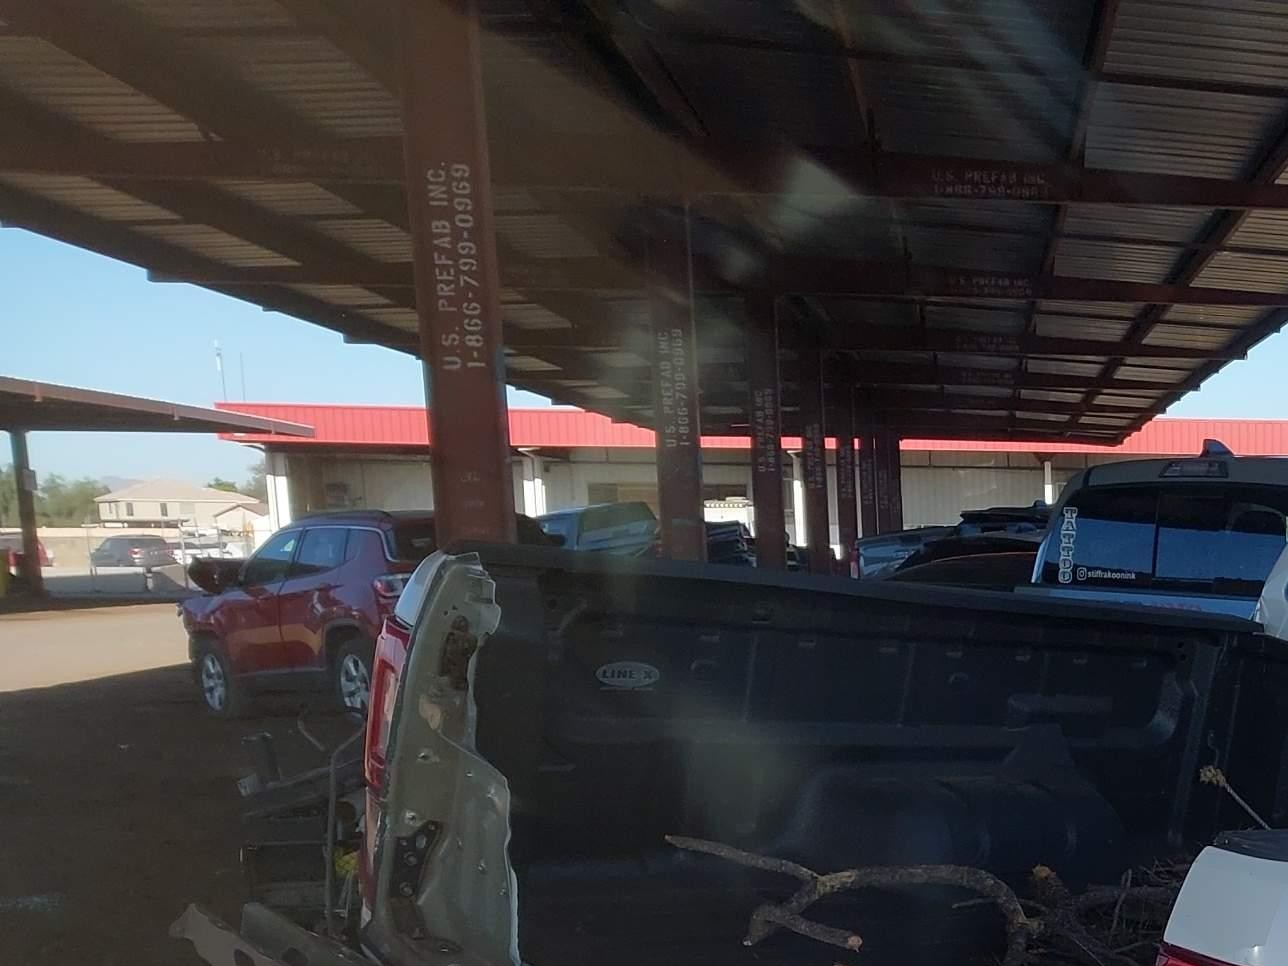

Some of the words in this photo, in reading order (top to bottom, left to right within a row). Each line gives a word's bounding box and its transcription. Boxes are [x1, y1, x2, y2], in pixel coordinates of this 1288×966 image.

[426, 161, 449, 206] INC.
[431, 219, 458, 312] PREFAB
[451, 163, 487, 368] 1-866-799-0969
[441, 326, 462, 370] U.S.
[1058, 507, 1078, 583] TATTOO
